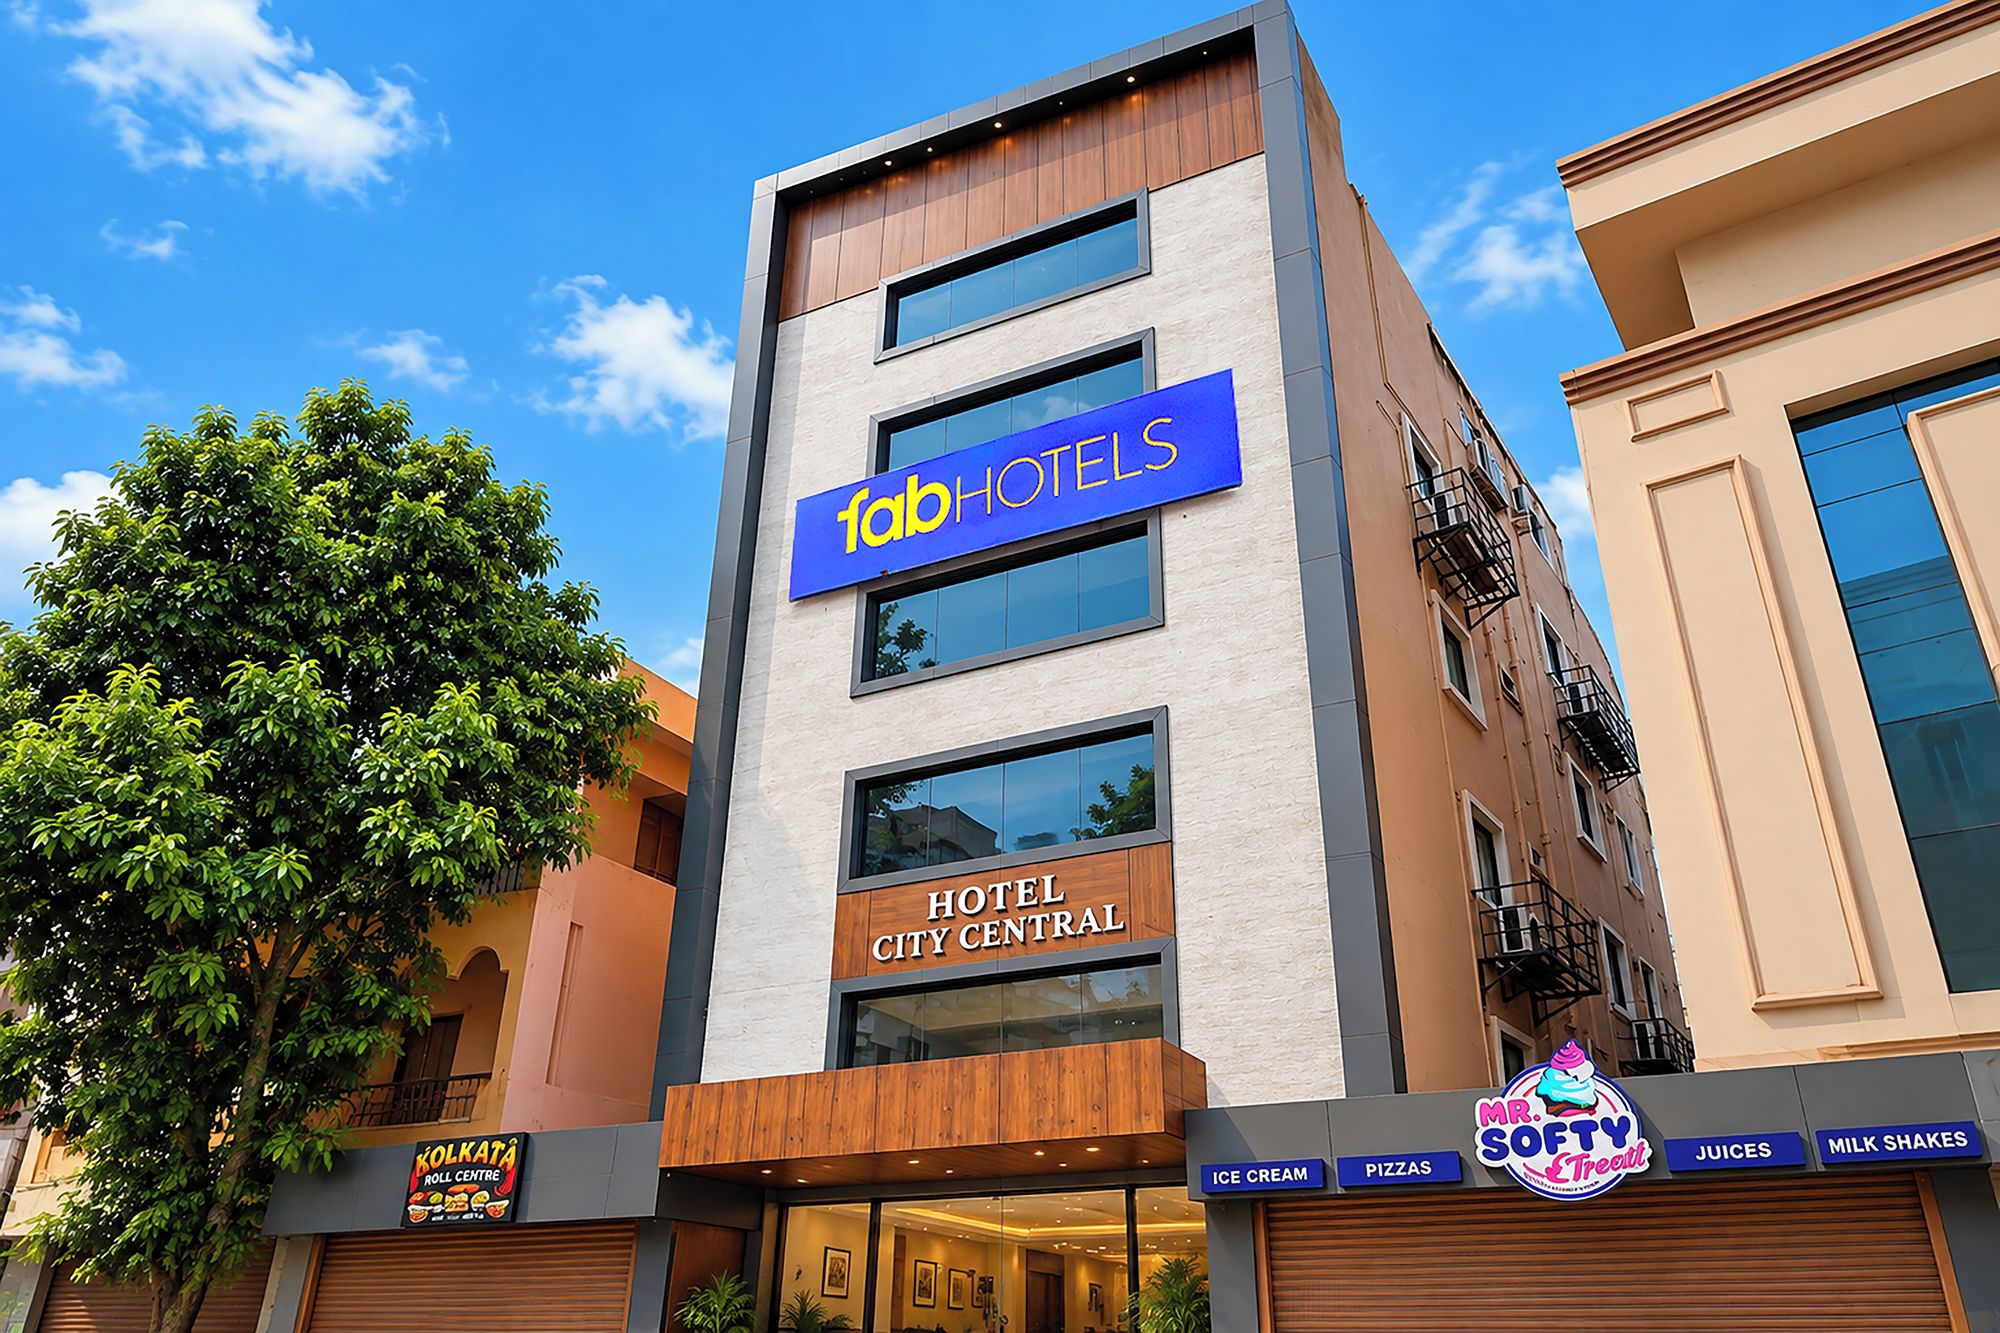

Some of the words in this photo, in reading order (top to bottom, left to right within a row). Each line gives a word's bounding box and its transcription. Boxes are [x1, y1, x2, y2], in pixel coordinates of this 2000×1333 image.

[927, 874, 1064, 921] HOTEL
[872, 927, 952, 962] CITY
[959, 903, 1124, 950] CENTRAL
[1479, 1099, 1541, 1127] MR.
[1481, 1115, 1631, 1161] SOFTY
[1828, 1135, 1879, 1154] MILK
[1884, 1131, 1968, 1151] SHAKES
[415, 1137, 518, 1177] KOLKATA
[1696, 1142, 1772, 1161] JUICES
[424, 1171, 452, 1187] ROLL
[455, 1169, 501, 1182] CENTRE
[1213, 1170, 1241, 1185] ICE
[1246, 1167, 1308, 1183] CREAM
[1365, 1160, 1432, 1178] PIZZAS
